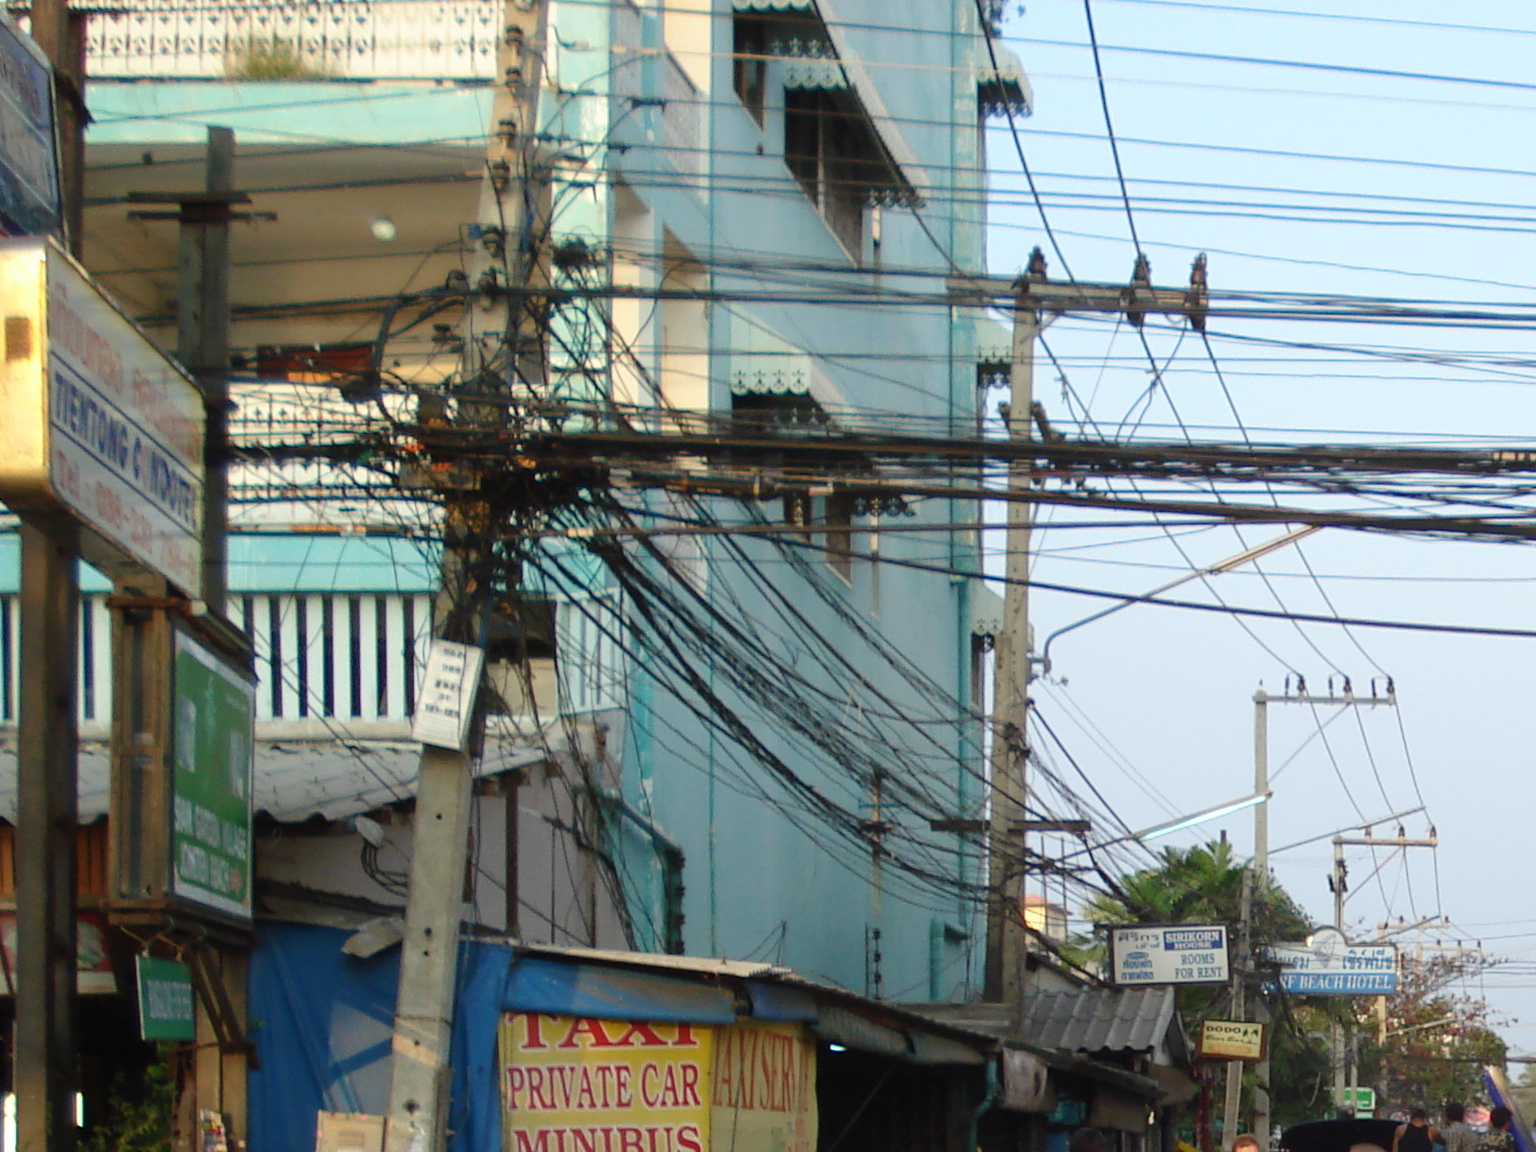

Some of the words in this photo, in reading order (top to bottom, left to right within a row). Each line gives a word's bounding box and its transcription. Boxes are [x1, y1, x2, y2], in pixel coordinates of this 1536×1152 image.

[1165, 931, 1220, 943] SIRIKORN
[1174, 941, 1212, 950] HOUSE
[1181, 953, 1215, 966] ROOMS
[1175, 968, 1194, 979] FOR
[1198, 966, 1222, 978] RENT
[1300, 975, 1344, 989] BEACH
[1346, 975, 1392, 990] HOTEL
[508, 1012, 698, 1049] TAXI
[1206, 1026, 1241, 1034] DODO
[712, 1024, 759, 1111] TAXI
[507, 1064, 633, 1111] PRIVATE
[642, 1063, 701, 1107] CAR
